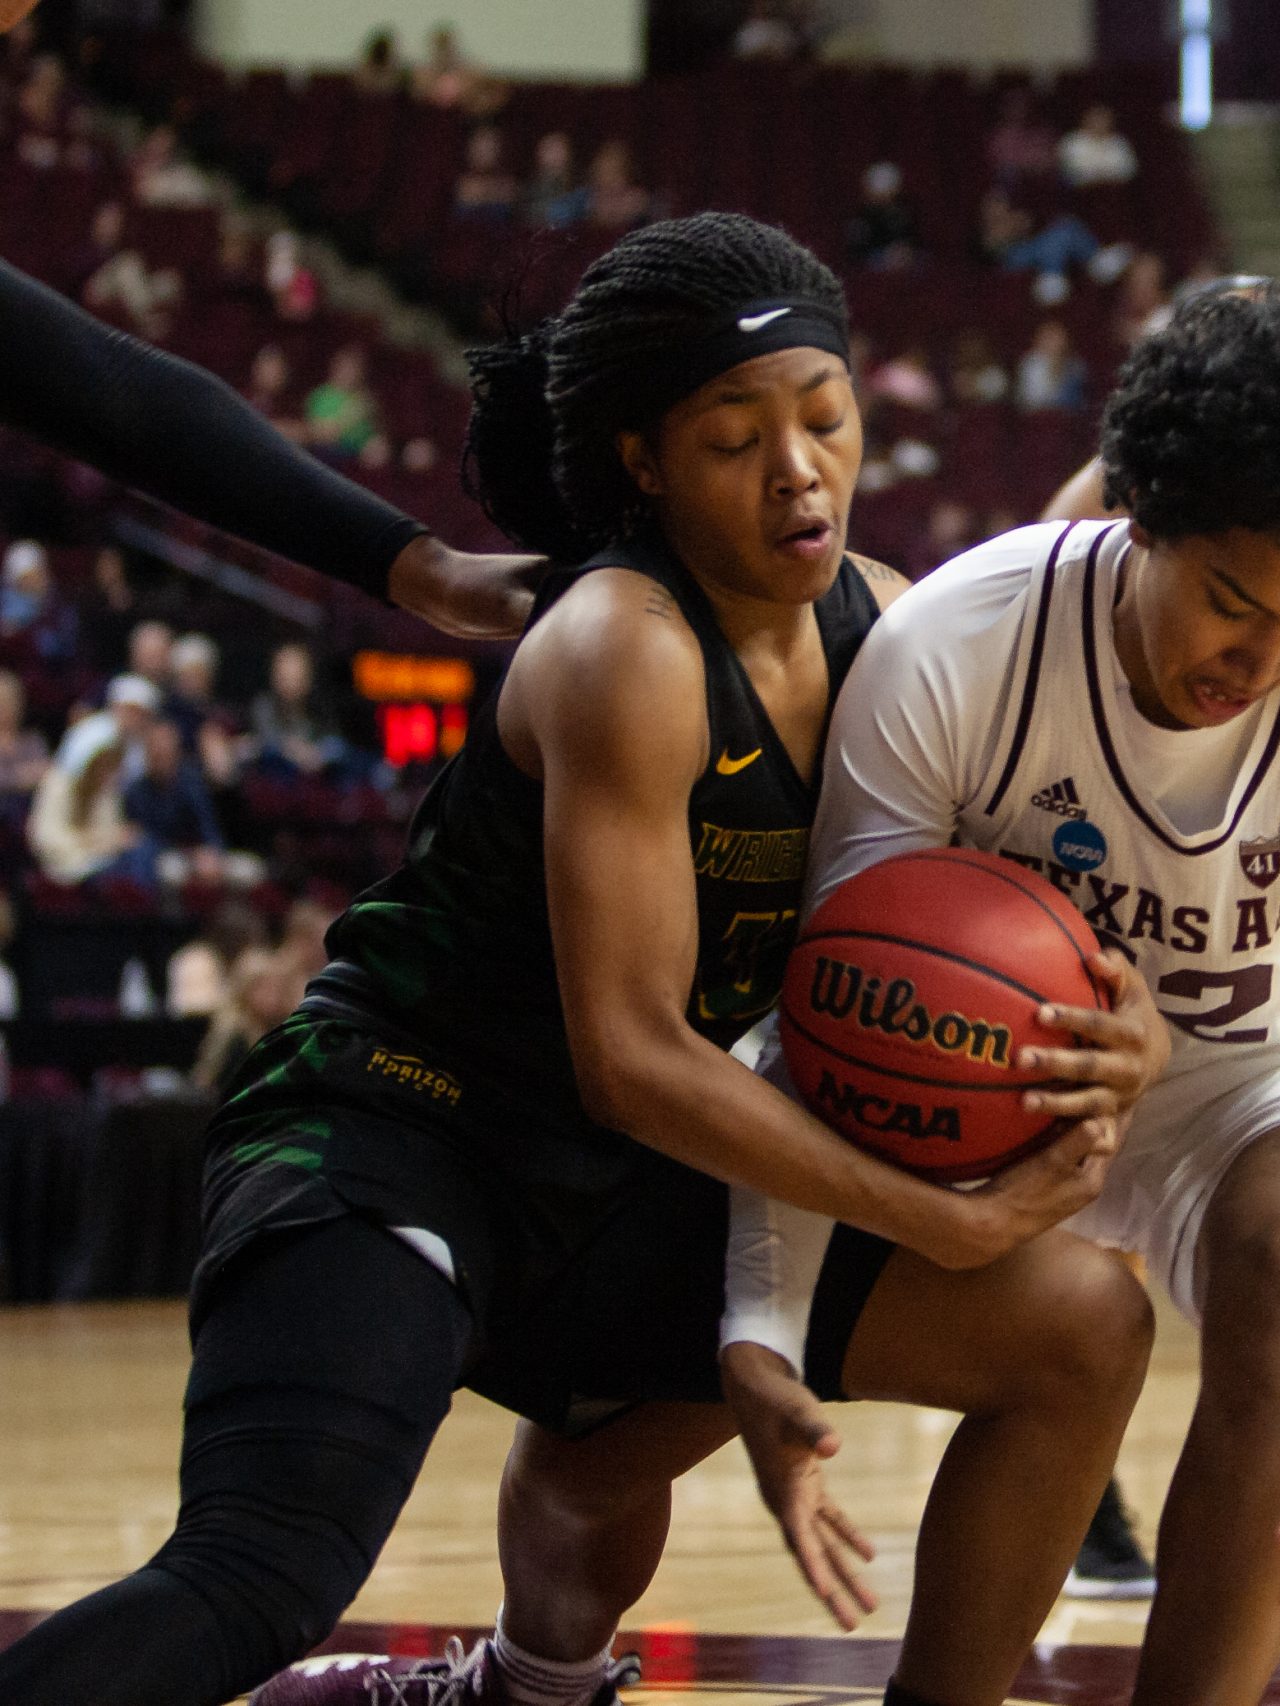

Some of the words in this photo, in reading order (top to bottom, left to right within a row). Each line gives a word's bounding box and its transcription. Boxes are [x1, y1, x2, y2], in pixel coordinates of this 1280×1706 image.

[1246, 853, 1276, 876] 41
[811, 956, 1011, 1068] Wilson
[371, 1051, 462, 1099] HORIZON
[816, 1070, 961, 1141] NCAA
